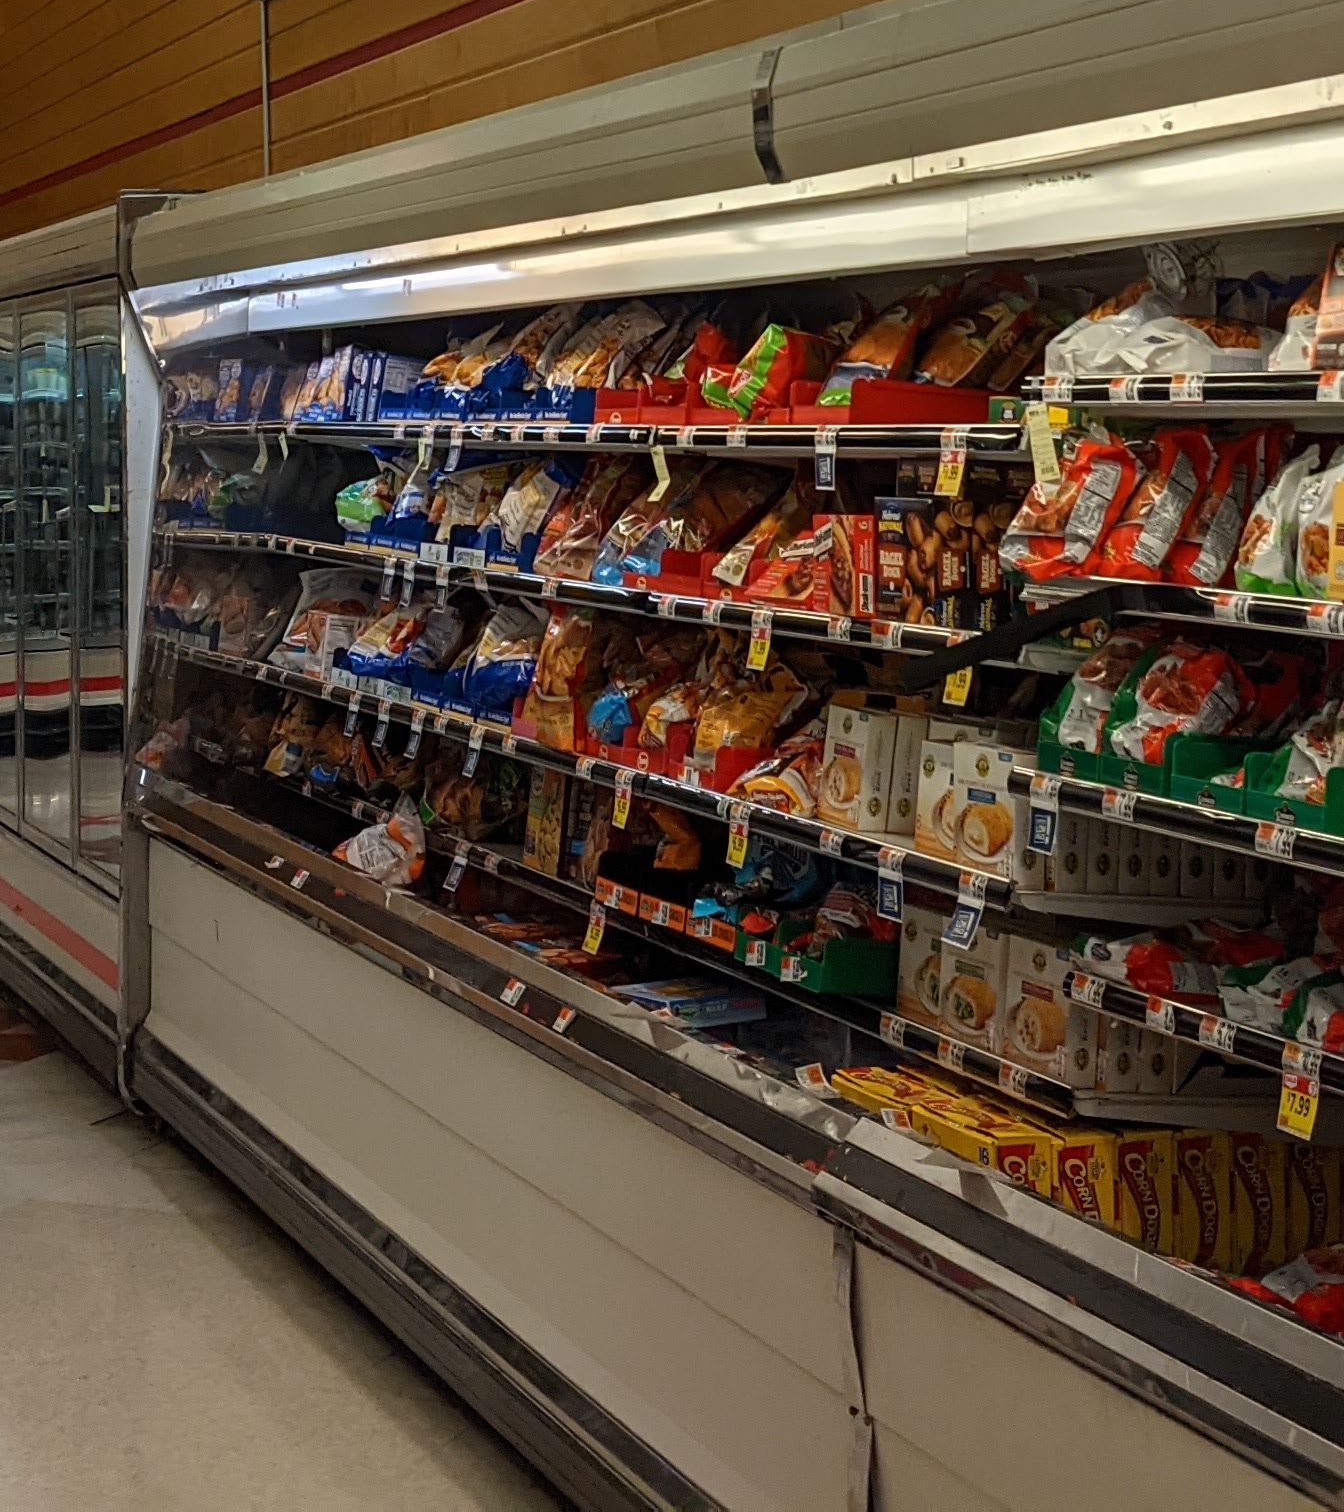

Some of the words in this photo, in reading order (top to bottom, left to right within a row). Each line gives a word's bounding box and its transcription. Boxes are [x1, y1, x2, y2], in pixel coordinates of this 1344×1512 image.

[1286, 1092, 1311, 1118] $7.99
[1064, 1157, 1095, 1210] CORN
[1124, 1152, 1153, 1204] CORN
[1184, 1148, 1209, 1200] CORN
